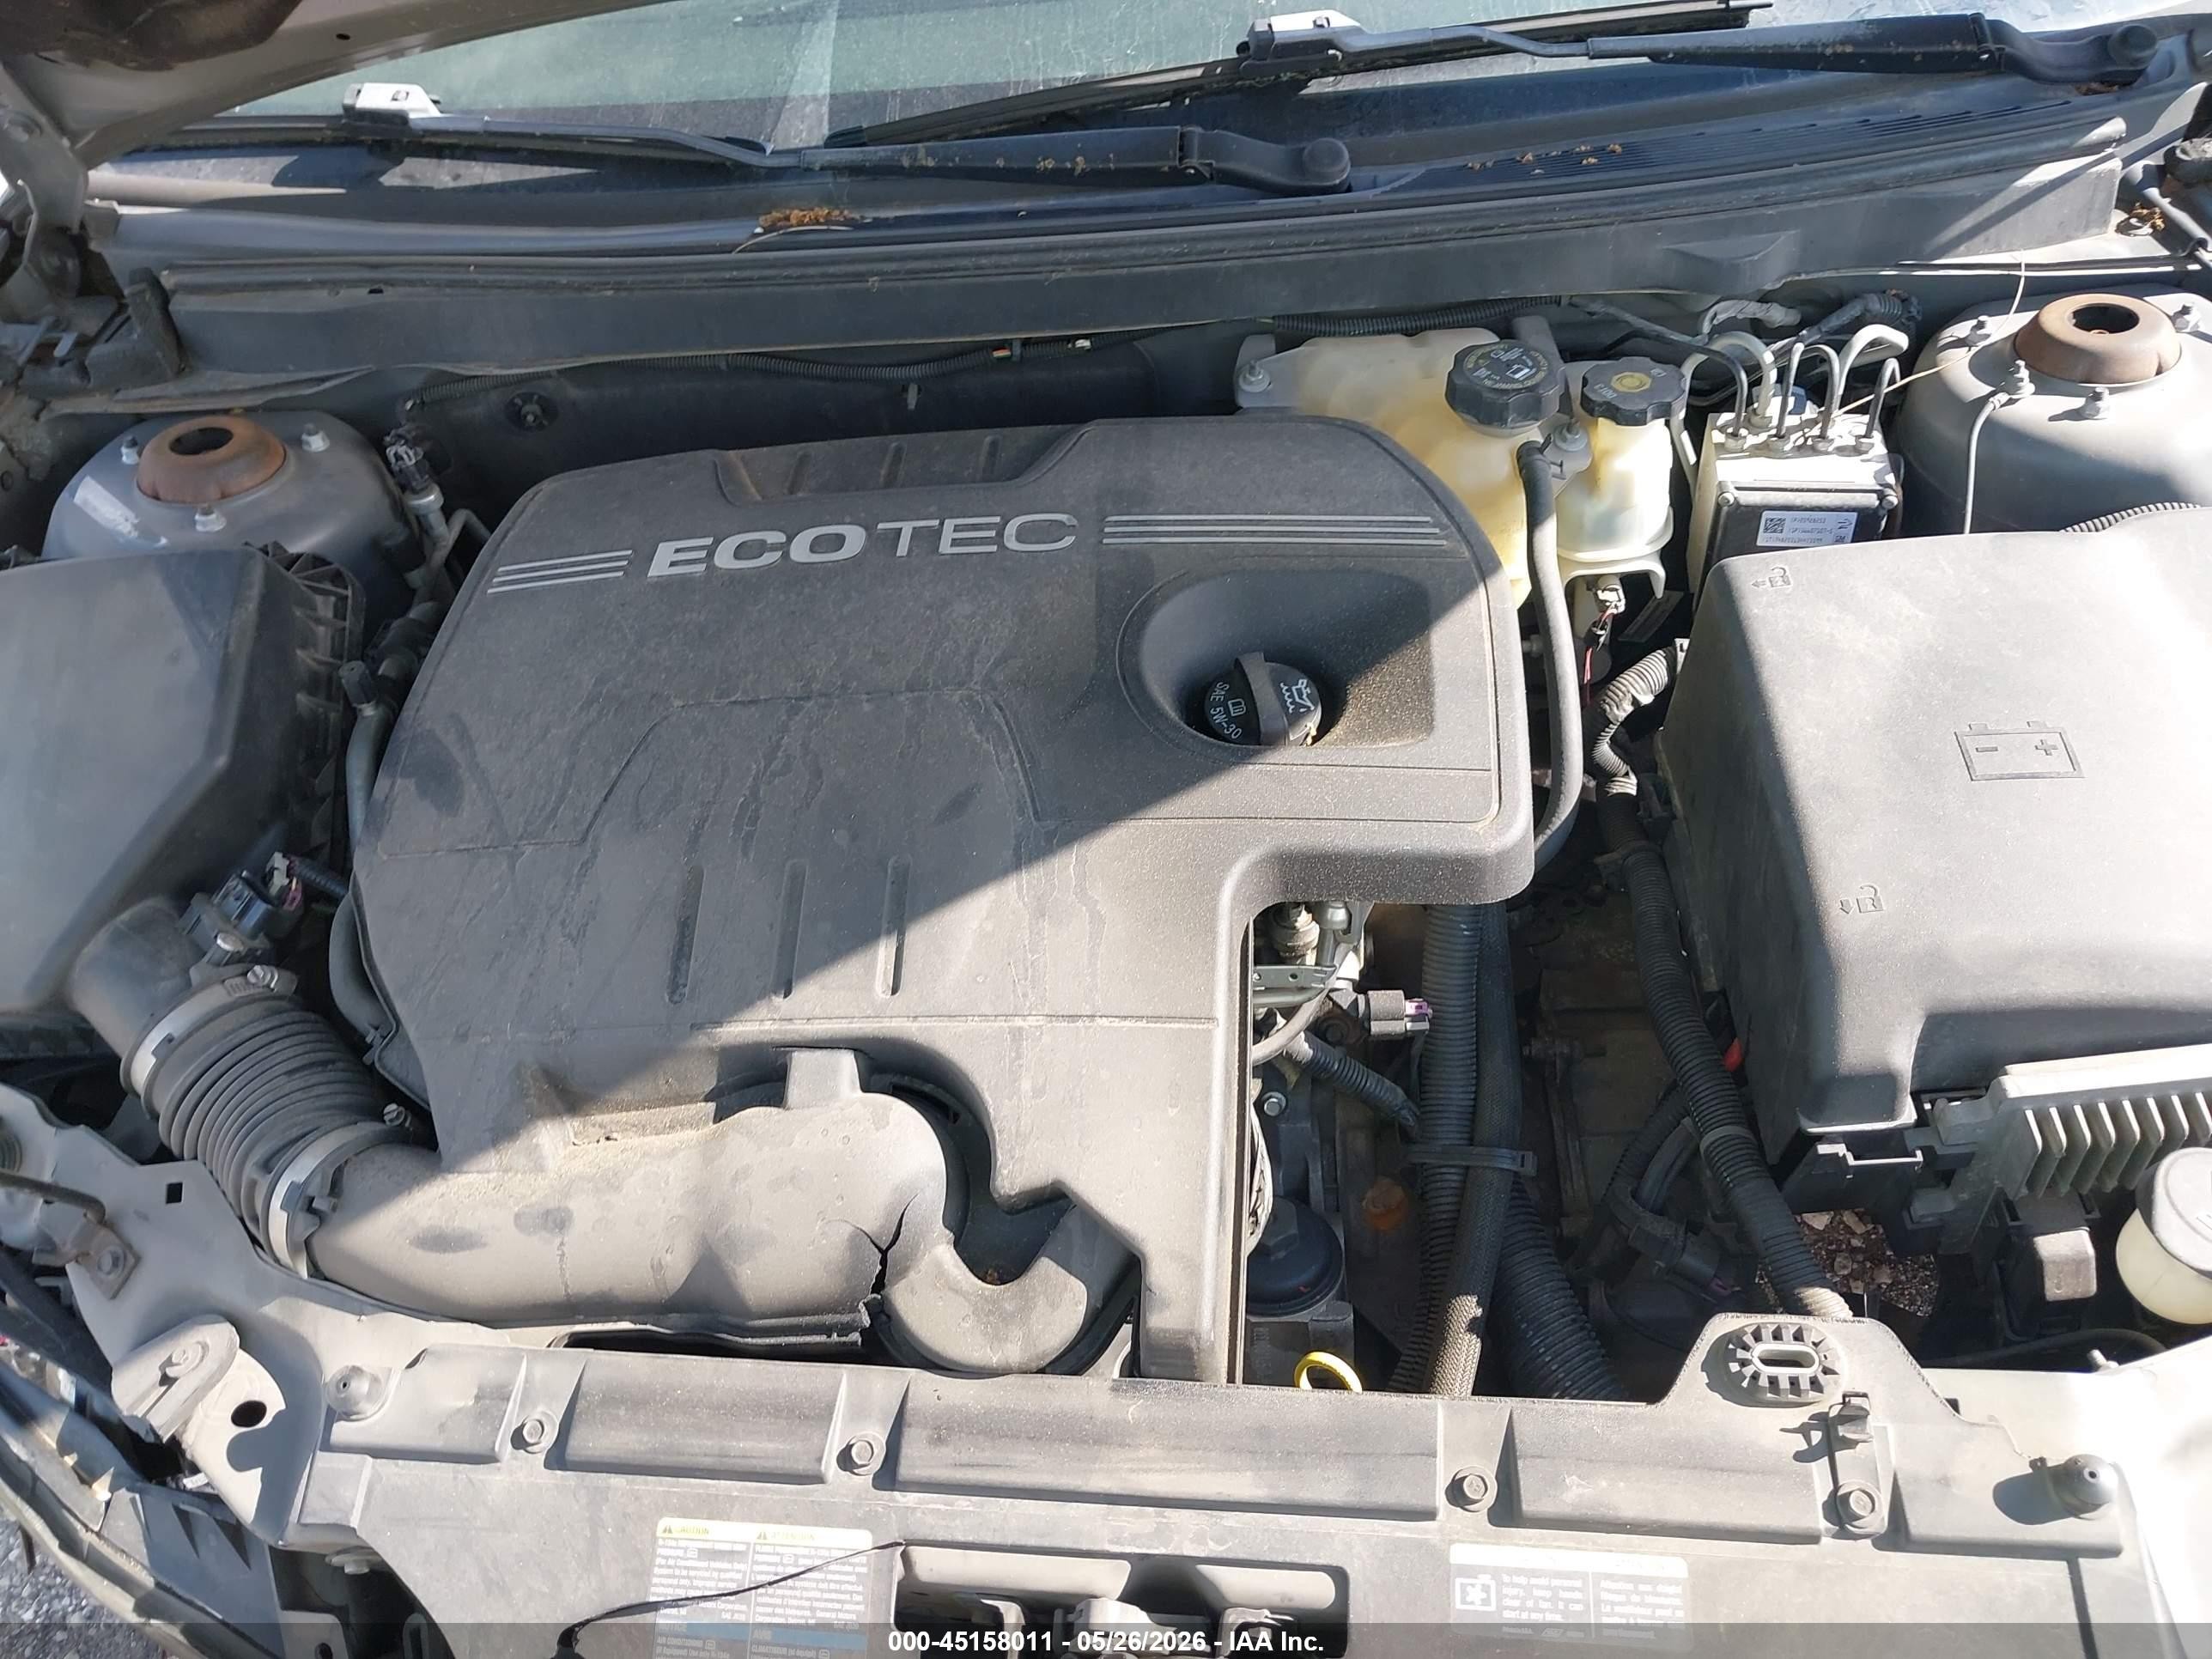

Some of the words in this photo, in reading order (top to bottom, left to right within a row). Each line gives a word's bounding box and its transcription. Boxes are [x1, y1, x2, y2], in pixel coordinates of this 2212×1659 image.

[646, 513, 1078, 578] ECOTEC
[1210, 681, 1230, 702] SAE
[1210, 706, 1243, 740] 5W-30
